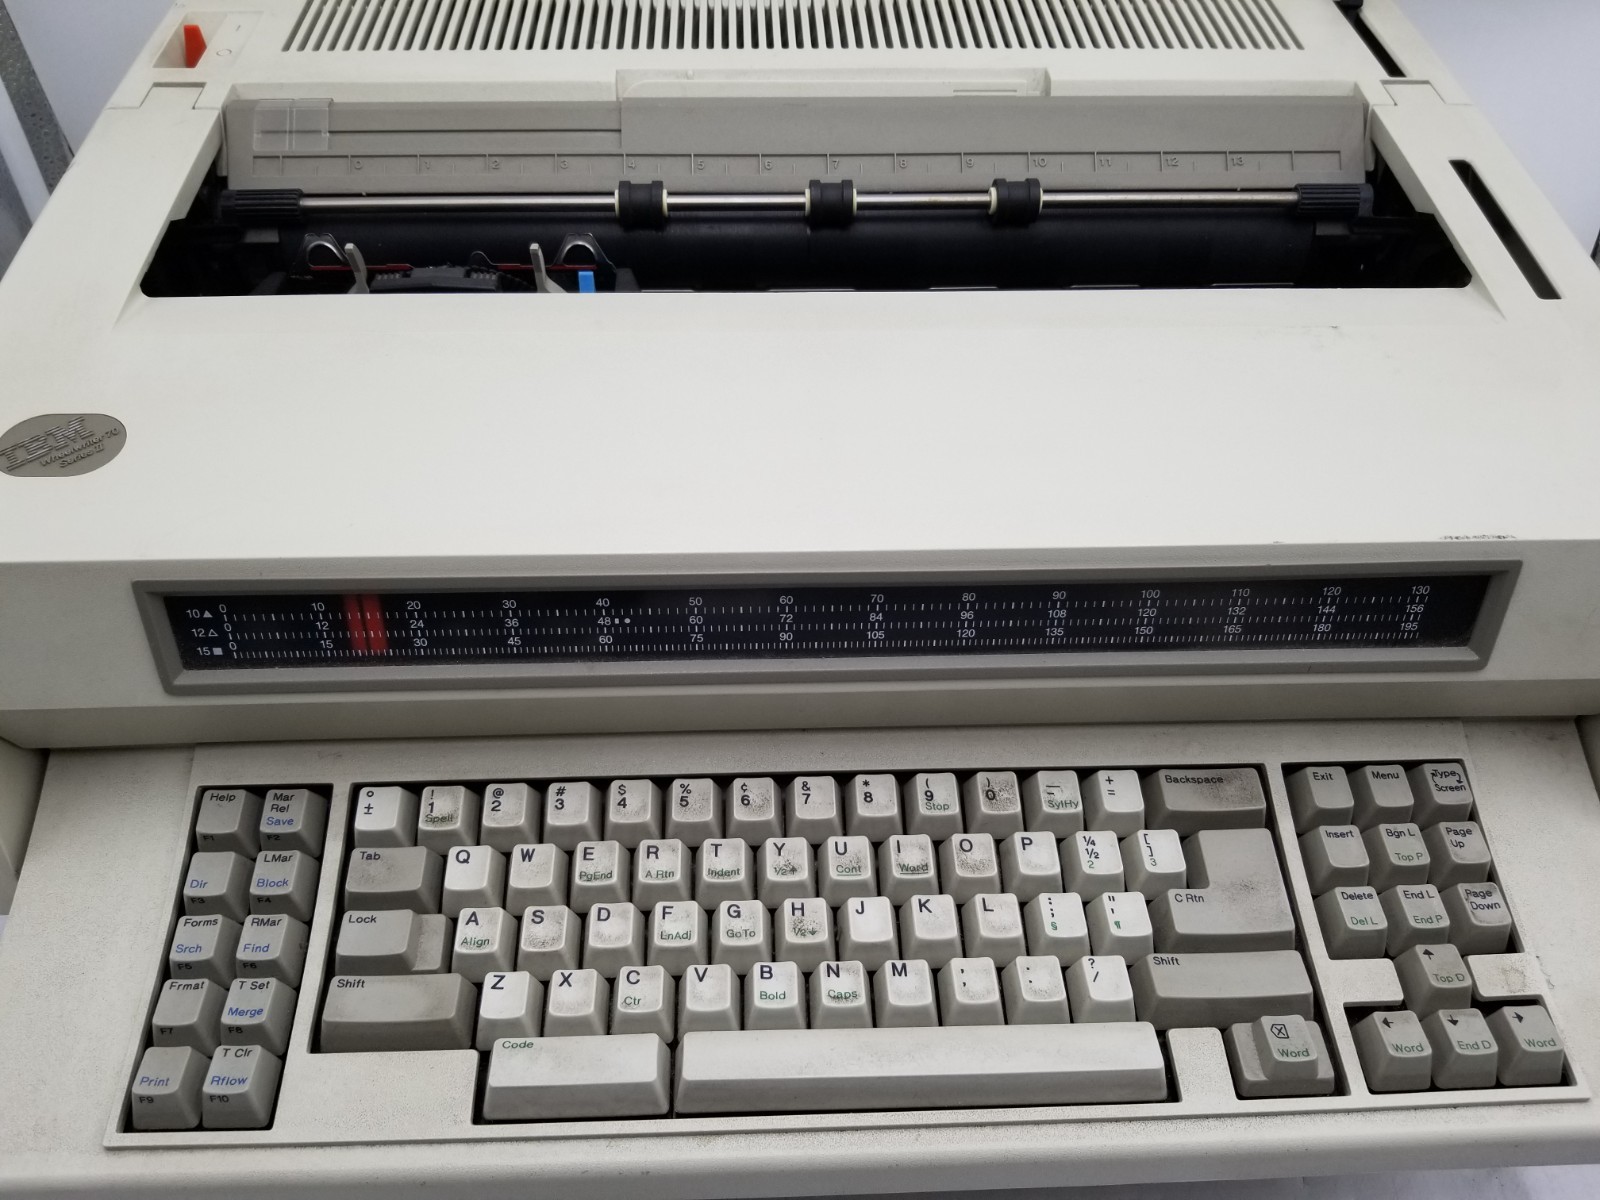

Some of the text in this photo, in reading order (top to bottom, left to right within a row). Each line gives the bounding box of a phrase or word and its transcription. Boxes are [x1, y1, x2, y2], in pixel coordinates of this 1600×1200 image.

[628, 156, 1244, 170] 4 6 10 12 13
[0, 416, 94, 472] IBM
[186, 585, 1430, 619] 10 10 20 30 40 50 60 70 80 90 100 110 120 130
[191, 604, 1424, 637] 12 12 24 36 48 60 72 84 96 108 120 132 144 156
[197, 622, 1418, 656] 15 15 30 45 60 75 90 105 120 135 150 165 180 195
[1312, 772, 1333, 781] Exit
[1371, 770, 1400, 780] Menu
[1431, 769, 1457, 779] Type
[1164, 775, 1224, 784] Backspace
[1434, 783, 1467, 792] Screen
[209, 793, 236, 802] Help
[273, 792, 295, 801] Mar
[802, 793, 811, 805] 7
[863, 792, 874, 803] 8
[924, 790, 934, 801] 9
[491, 800, 502, 812] 2
[554, 798, 565, 810] 3
[617, 797, 627, 809] 4
[679, 796, 690, 808] 5
[925, 801, 950, 811] Stop
[270, 803, 289, 813] Rel
[266, 816, 294, 826] Save
[424, 813, 453, 824] Spell
[1325, 829, 1354, 839] Insert
[1385, 828, 1416, 839] Bgn L
[1445, 826, 1473, 837] Page
[834, 841, 848, 855] U
[1020, 836, 1033, 851] P
[1450, 839, 1465, 849] Up
[520, 848, 536, 862] W
[582, 847, 595, 861] E
[646, 845, 660, 860] R
[710, 843, 722, 857] T
[263, 854, 293, 863] LMar
[360, 851, 381, 861] Tab
[455, 850, 471, 864] Q
[1395, 852, 1424, 862] Top P
[707, 867, 740, 877] Indent
[836, 864, 862, 874] Cont
[899, 862, 929, 873] Word
[579, 870, 613, 881] PgEnd
[645, 870, 675, 879] A Rtn
[190, 879, 208, 889] Dir
[256, 878, 289, 888] Block
[1174, 893, 1205, 903] C Rtn
[1341, 891, 1374, 901] Delete
[1403, 890, 1435, 900] End L
[1465, 888, 1493, 898] Page
[918, 898, 933, 914] K
[982, 897, 994, 912] L
[1469, 900, 1501, 910] Down
[531, 909, 545, 924] S
[597, 907, 611, 921] D
[662, 905, 674, 920] F
[726, 904, 742, 919] G
[183, 918, 219, 927] Forms
[250, 917, 282, 927] RMar
[348, 914, 377, 924] Lock
[465, 911, 479, 926] A
[1350, 916, 1378, 926] Del L
[1413, 914, 1443, 924] End P
[660, 930, 692, 941] LnAdj
[726, 929, 756, 938] GoTo
[461, 936, 490, 948] Align
[175, 943, 202, 953] Srch
[243, 943, 270, 952] Find
[1152, 956, 1180, 966] Shift
[694, 967, 708, 982] V
[759, 965, 773, 980] B
[826, 963, 840, 978] N
[891, 962, 908, 977] M
[490, 974, 506, 990] Z
[558, 972, 573, 987] X
[626, 970, 641, 985] C
[1433, 973, 1465, 983] Top D
[169, 981, 205, 990] Frmat
[238, 981, 270, 990] T Set
[336, 978, 366, 989] Shift
[759, 991, 786, 1000] Bold
[827, 989, 858, 1000] Caps
[623, 996, 641, 1006] Ctr
[227, 1007, 264, 1018] Merge
[502, 1040, 534, 1049] Code
[1457, 1040, 1491, 1050] End D
[1524, 1038, 1557, 1048] Word
[223, 1048, 253, 1058] T Clr
[1277, 1048, 1310, 1058] Word
[1391, 1043, 1424, 1054] Word
[140, 1076, 170, 1086] Print
[210, 1076, 248, 1086] Rflow
[209, 1095, 229, 1103] F10
